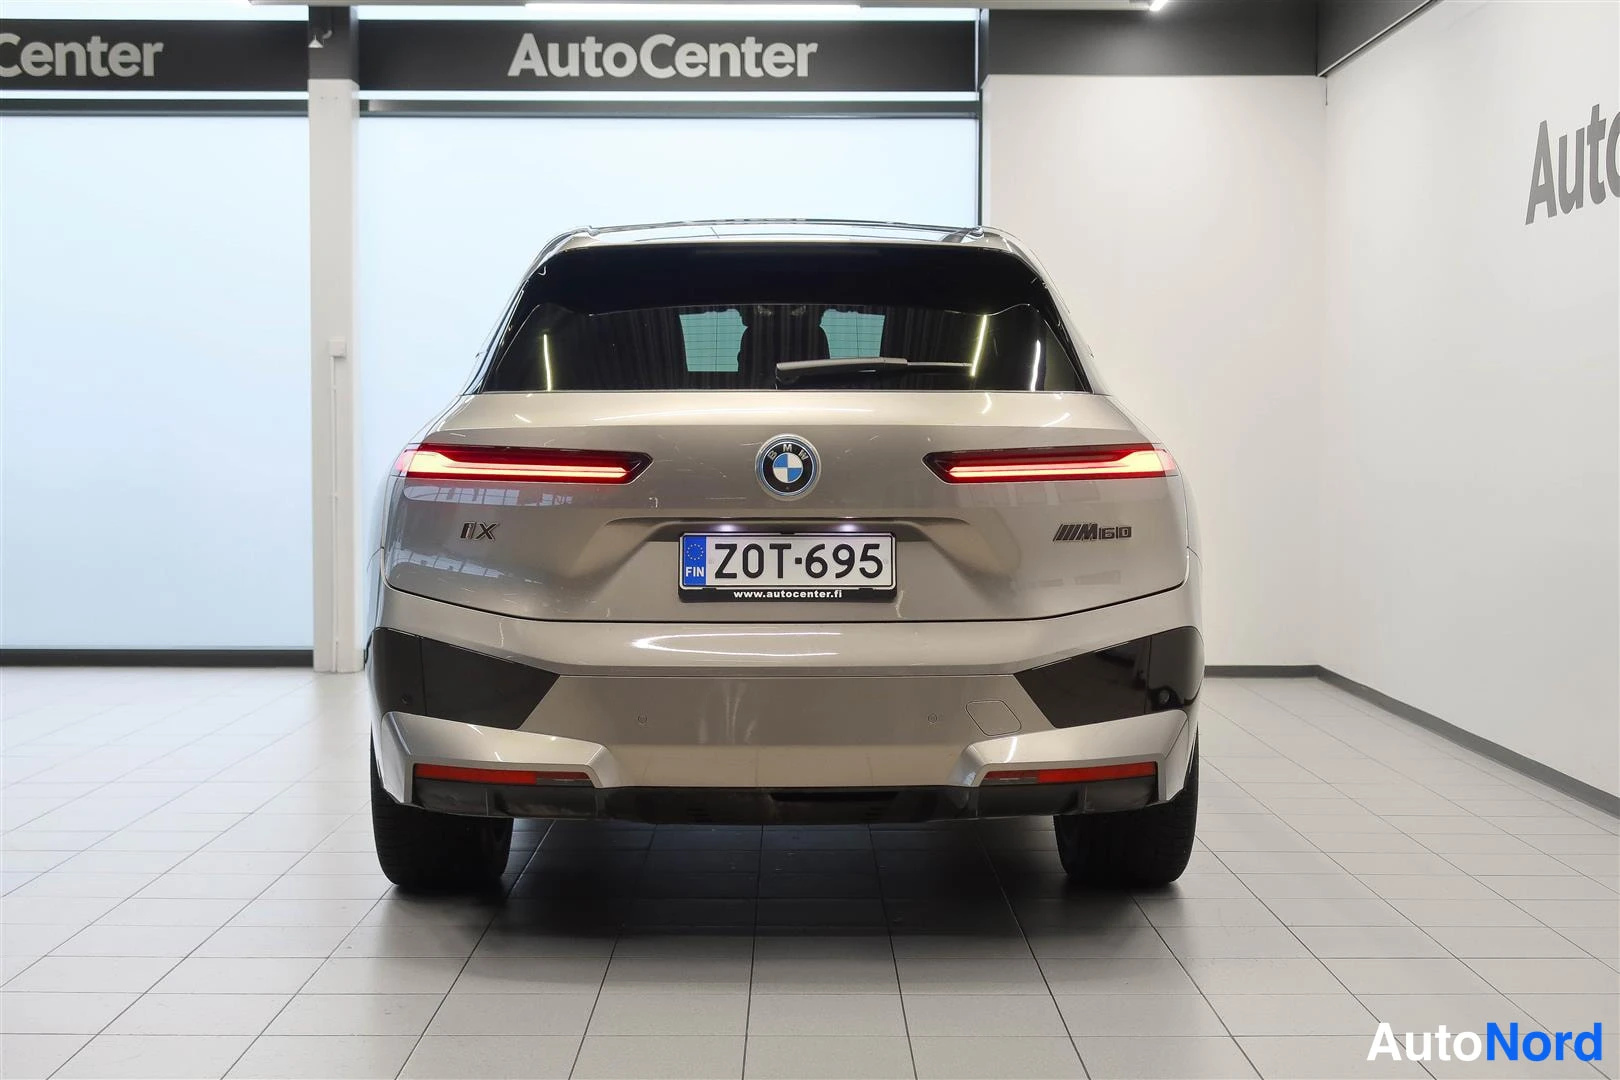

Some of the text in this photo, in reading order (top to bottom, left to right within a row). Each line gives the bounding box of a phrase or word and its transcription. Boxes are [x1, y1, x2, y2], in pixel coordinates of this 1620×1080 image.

[0, 32, 164, 78] Center
[507, 32, 818, 79] AutoCenter
[767, 443, 809, 461] BMW
[685, 566, 705, 577] FIN
[714, 543, 884, 579] ZOT-695
[733, 589, 843, 599] www.autocenter.fi
